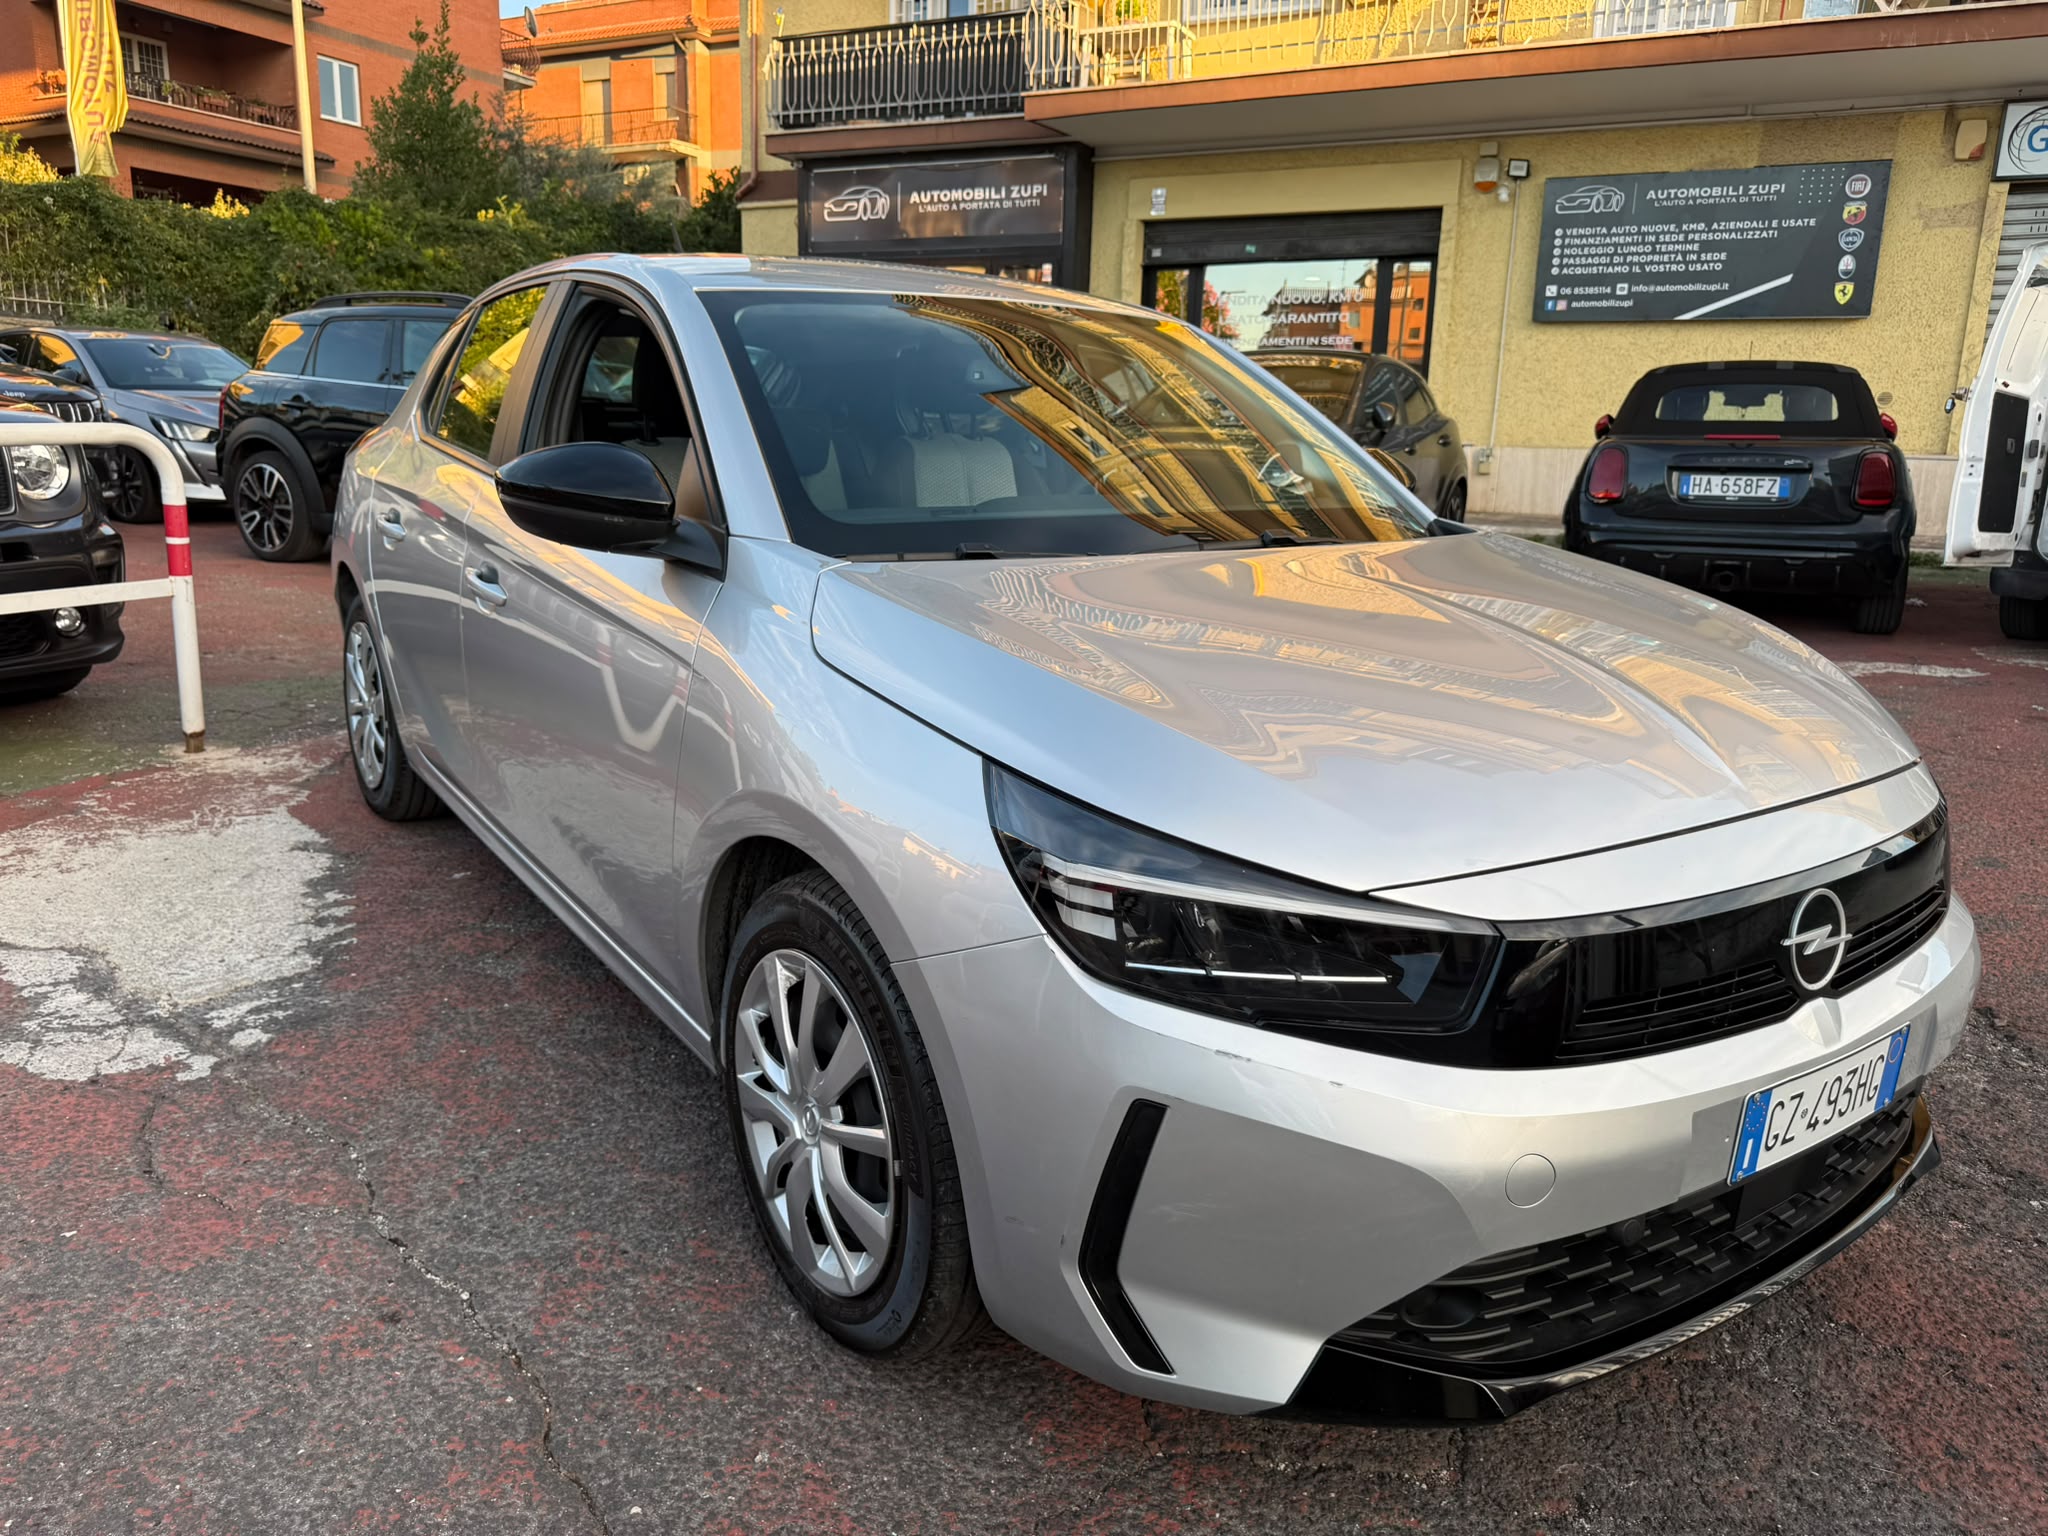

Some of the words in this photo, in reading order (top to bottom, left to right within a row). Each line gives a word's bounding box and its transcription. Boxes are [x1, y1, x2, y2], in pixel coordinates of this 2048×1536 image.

[909, 185, 1006, 204] AUTOMOBILI
[1010, 183, 1048, 199] ZUPI
[1646, 185, 1743, 200] AUTOMOBILI
[1748, 183, 1786, 195] ZUPI
[918, 203, 950, 213] L'AUTO
[951, 203, 958, 211] A
[960, 200, 1001, 211] PORTATA
[1002, 200, 1012, 209] DI
[1014, 199, 1041, 208] TUTTI
[1654, 199, 1686, 207] L'AUTO
[1687, 198, 1694, 206] A
[1696, 196, 1737, 205] PORTATA
[1751, 195, 1777, 203] TUTTI
[1566, 227, 1608, 236] VENDITA
[1610, 225, 1638, 234] AUTO
[1640, 223, 1679, 233] NUOVE,
[1711, 220, 1768, 231] AZIENDALI
[1771, 219, 1779, 228] E
[1782, 218, 1817, 228] USATE
[1564, 235, 1642, 246] FINANZIAMENTI
[1645, 234, 1656, 243] IN
[1658, 233, 1685, 242] SEDE
[1688, 230, 1778, 241] PERSONALIZZATI
[1563, 245, 1615, 256] NOLEGGIO
[1617, 244, 1652, 254] LUNGO
[1655, 242, 1700, 253] TERMINE
[1562, 255, 1610, 265] PASSAGGI
[1613, 255, 1624, 264] DI
[1626, 252, 1683, 263] PROPRIETÀ
[1686, 253, 1697, 261] IN
[1700, 252, 1728, 261] SEDE
[1561, 265, 1630, 275] ACQUISTIAMO
[1632, 264, 1642, 273] IL
[1644, 263, 1686, 273] VOSTRO
[1688, 262, 1723, 272] USATO
[1559, 287, 1572, 295] 06
[1270, 293, 1326, 305] NUOVO,
[1328, 292, 1351, 304] KM
[1571, 299, 1634, 309] automobilizupi
[1268, 311, 1350, 324] GARANTITO
[1306, 336, 1319, 346] IN
[1320, 336, 1354, 346] SEDE
